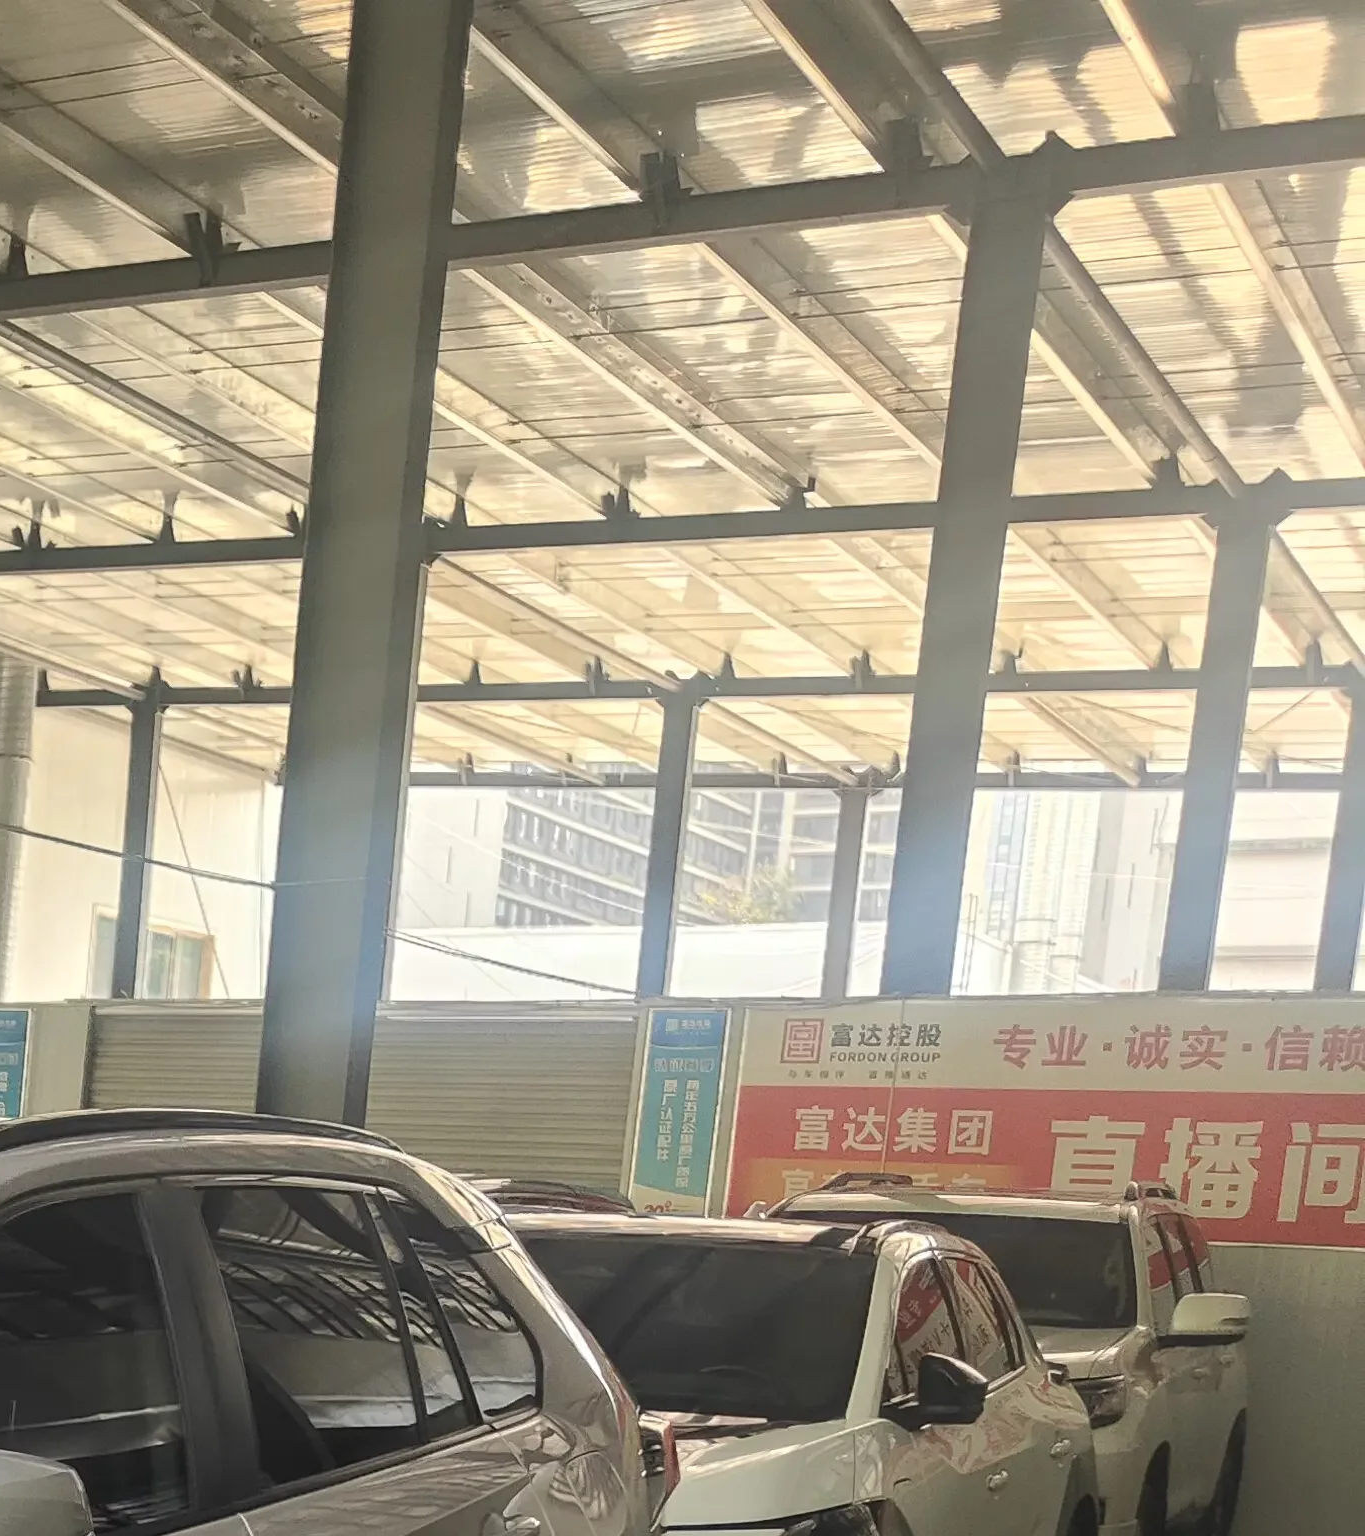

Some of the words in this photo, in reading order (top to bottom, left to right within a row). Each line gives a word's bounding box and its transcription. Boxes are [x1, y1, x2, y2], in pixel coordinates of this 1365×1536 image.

[830, 1023, 942, 1048] 富达控股
[829, 1051, 887, 1063] FORDON
[889, 1052, 942, 1063] GROUP
[793, 1104, 994, 1156] 富达集团
[1050, 1115, 1365, 1224] 直播间
